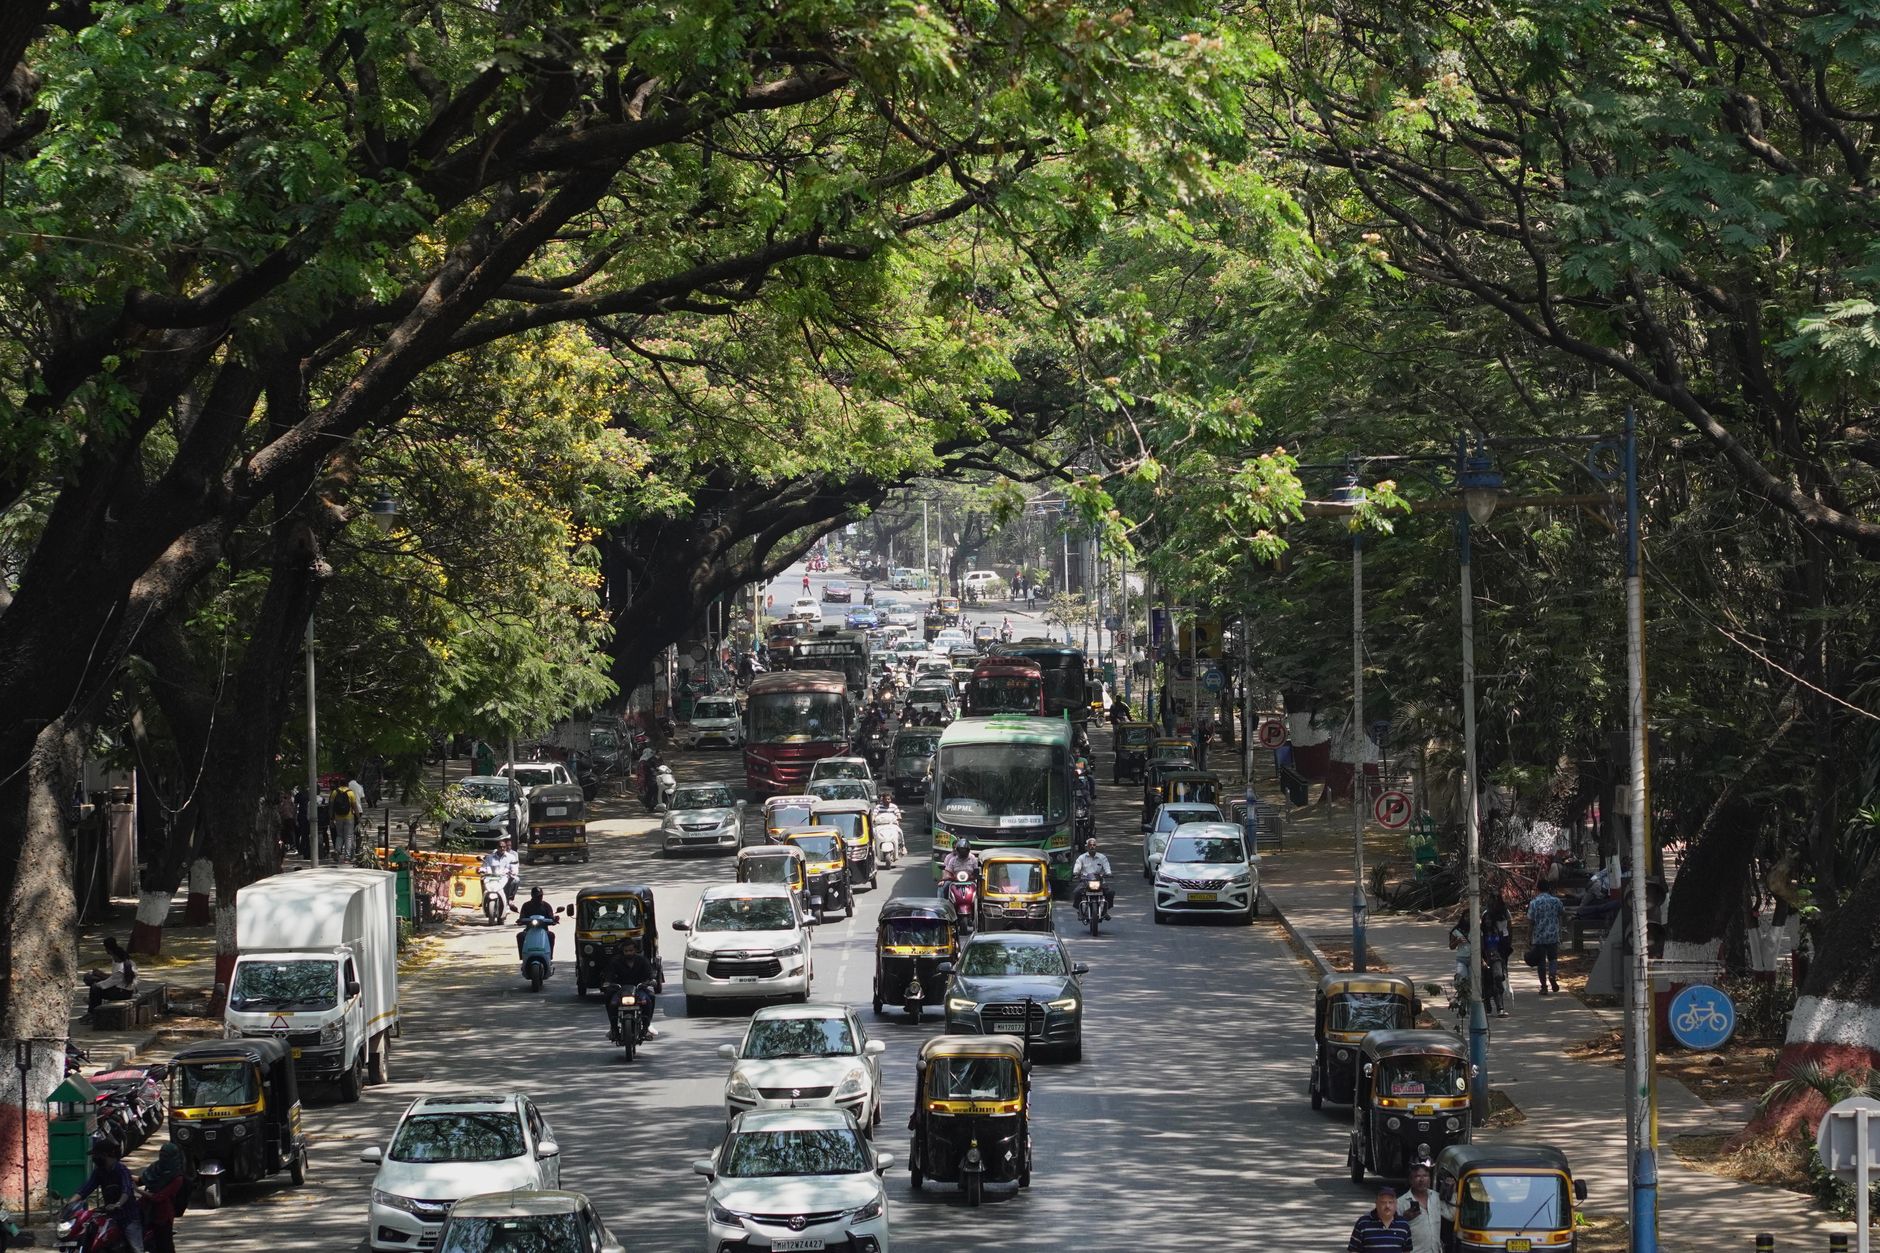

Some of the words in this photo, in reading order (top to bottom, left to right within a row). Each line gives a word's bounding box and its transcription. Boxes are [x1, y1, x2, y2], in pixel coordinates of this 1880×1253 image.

[1268, 726, 1281, 743] P
[946, 804, 973, 812] PMPML
[1386, 798, 1404, 822] P
